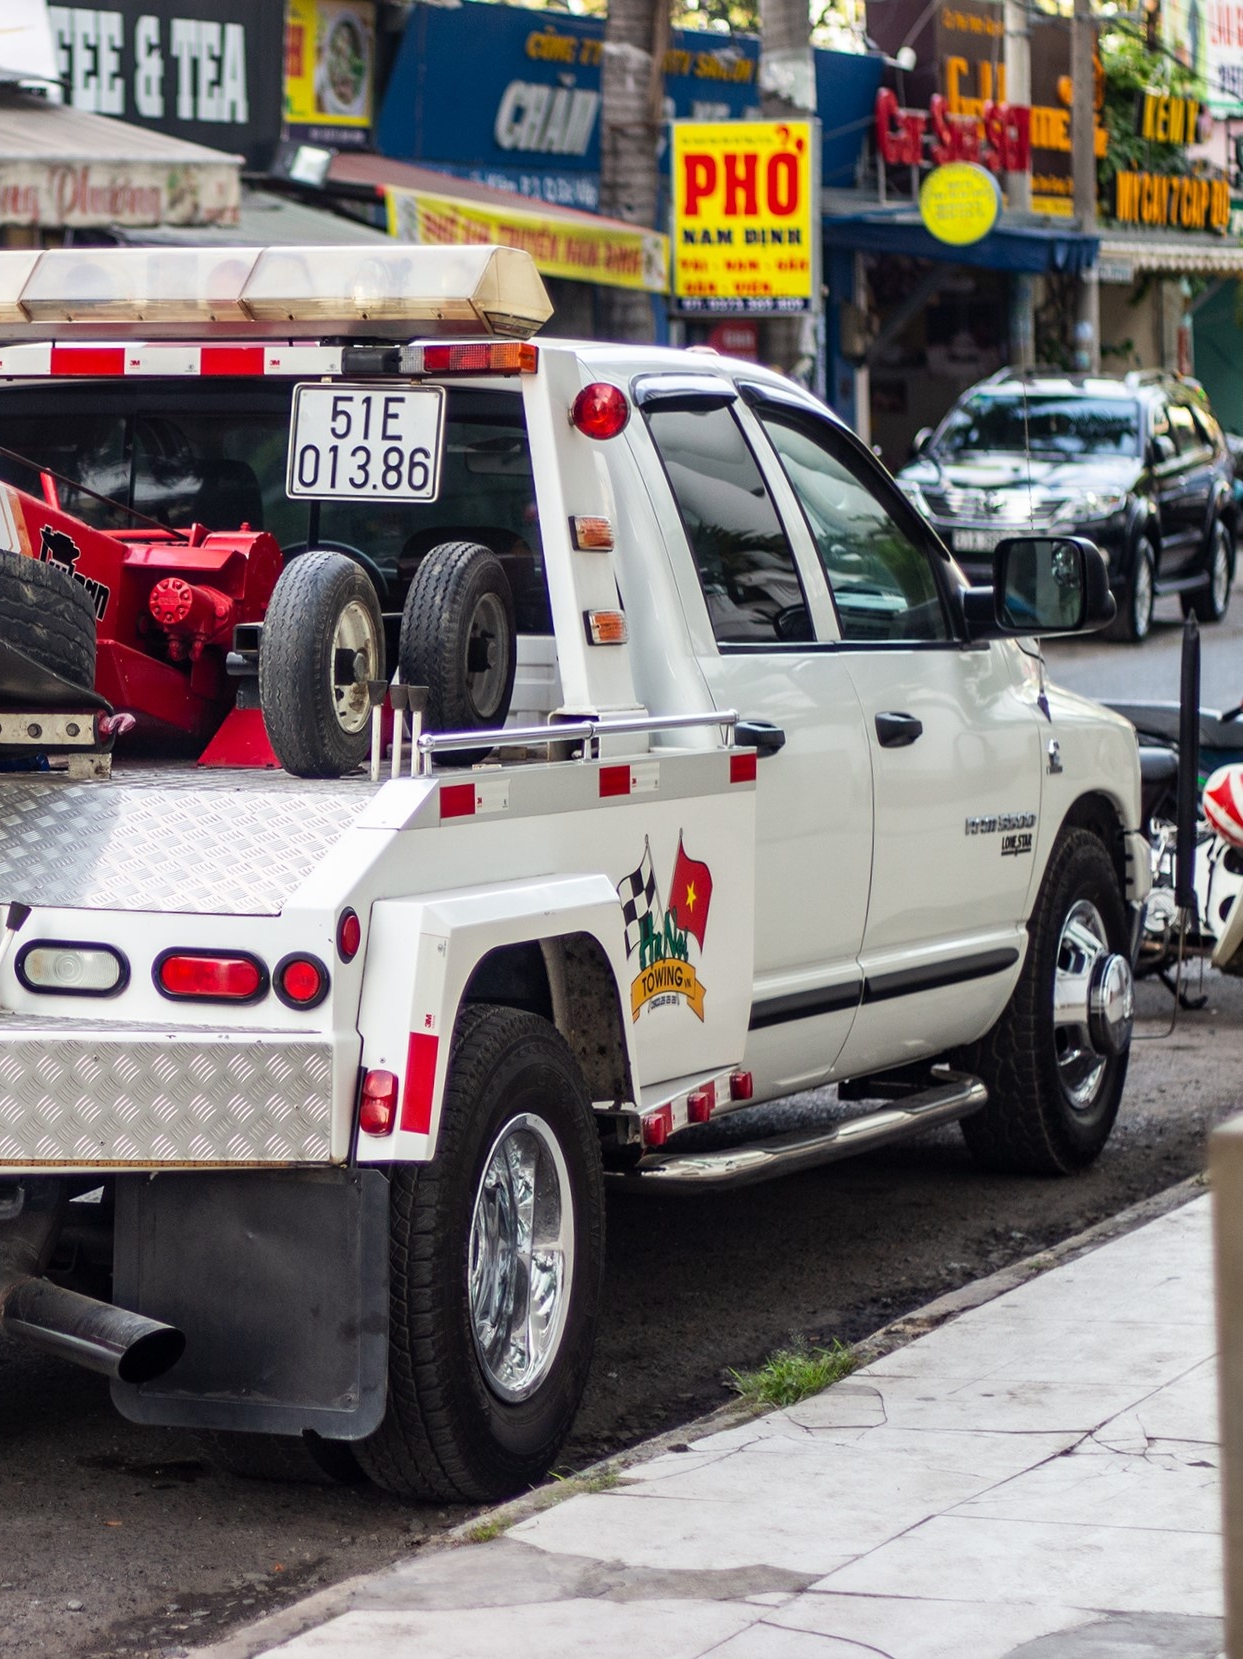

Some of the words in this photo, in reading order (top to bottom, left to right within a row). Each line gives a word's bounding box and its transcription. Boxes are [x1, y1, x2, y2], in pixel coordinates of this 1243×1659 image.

[135, 15, 164, 118] &
[170, 18, 249, 124] TEA
[683, 124, 805, 217] PHỞ
[682, 228, 734, 245] NAM
[130, 359, 141, 367] 3M
[269, 359, 281, 367] 3M
[329, 395, 406, 442] 51E
[297, 443, 432, 492] 013.86
[641, 966, 684, 998] TOWING
[424, 1013, 433, 1029] 3M
